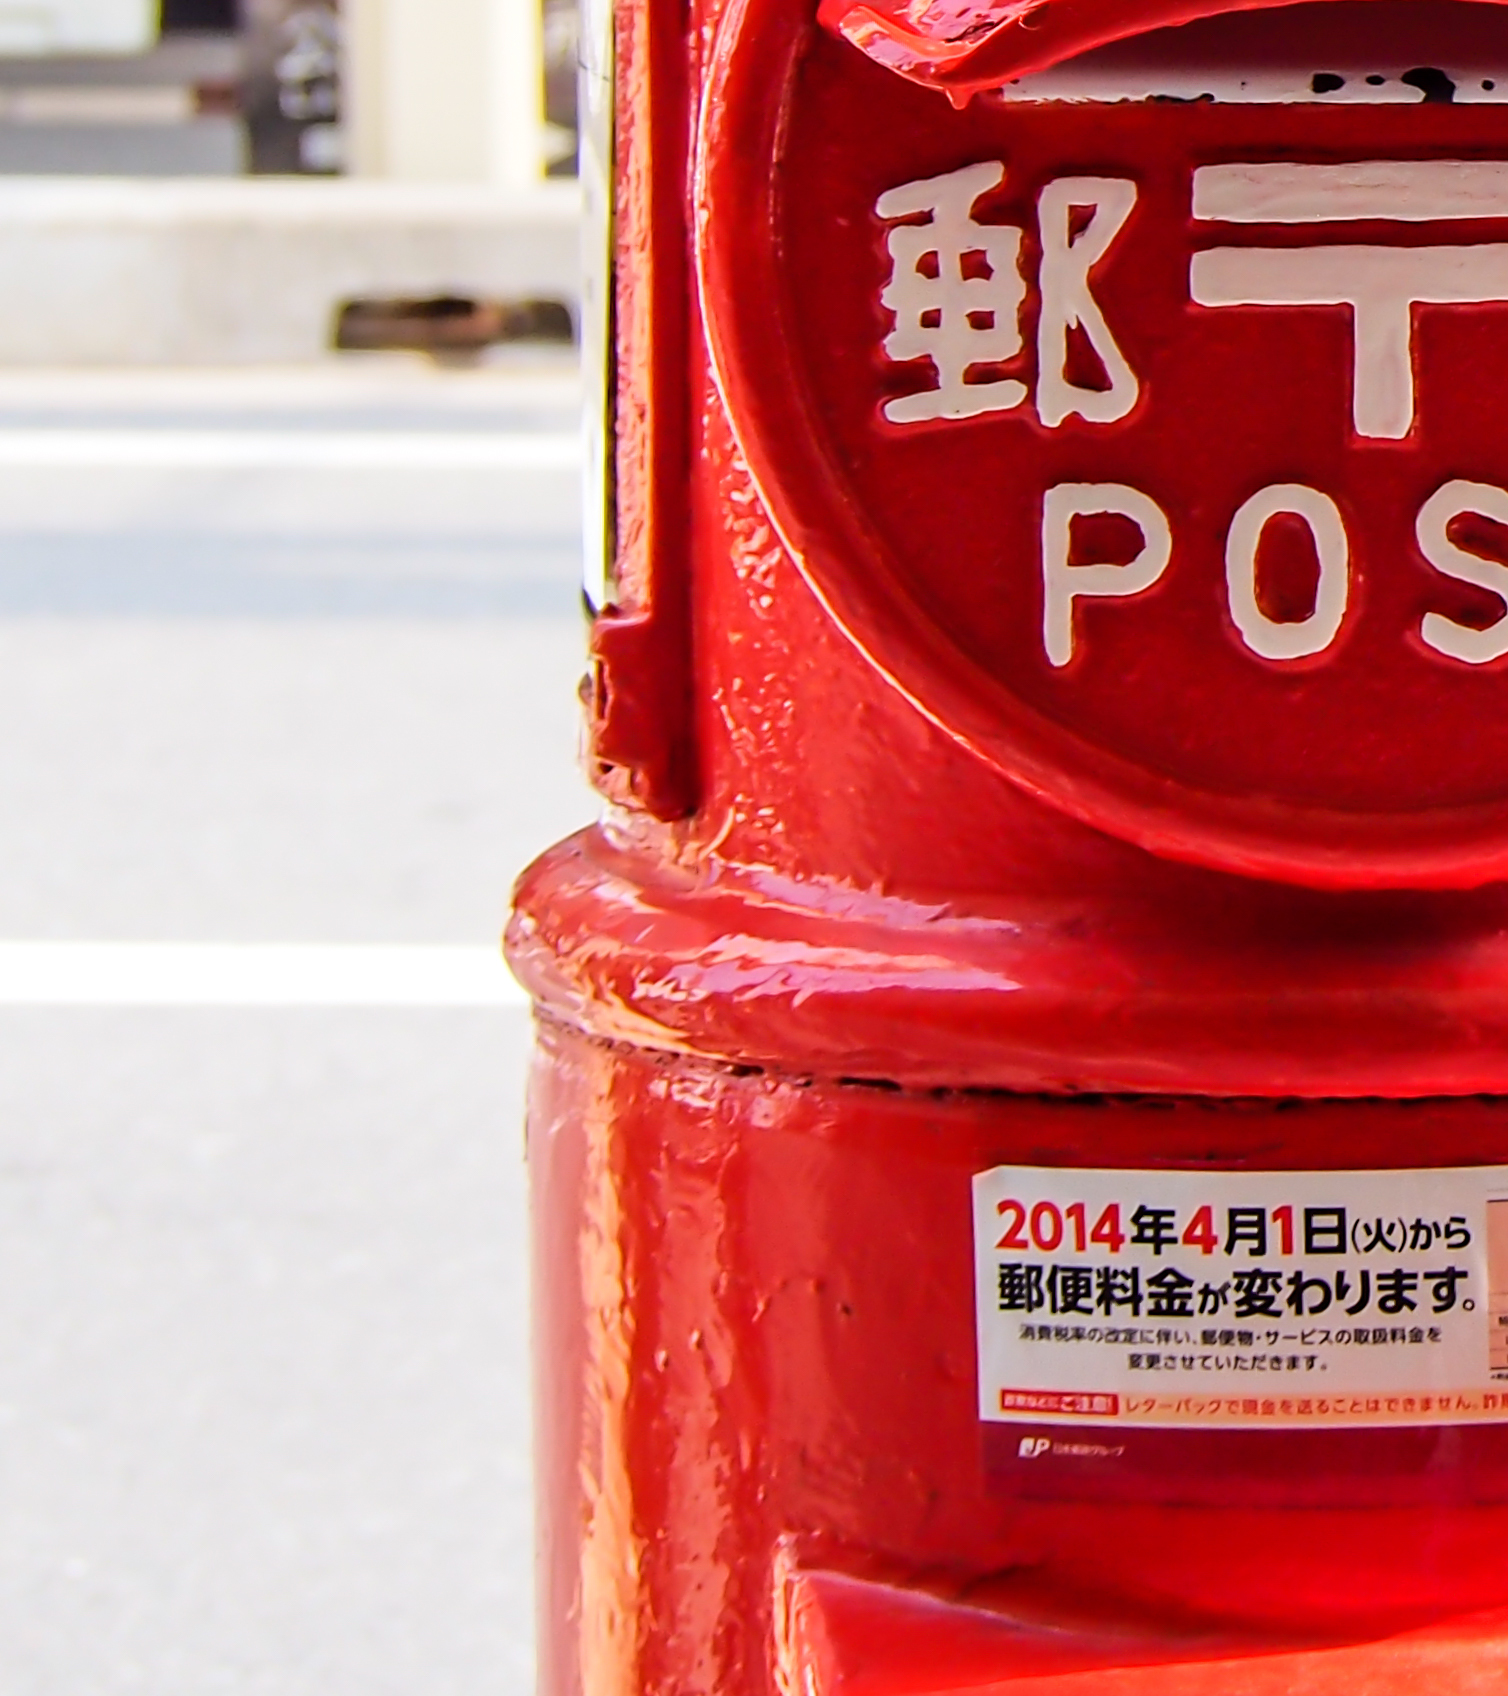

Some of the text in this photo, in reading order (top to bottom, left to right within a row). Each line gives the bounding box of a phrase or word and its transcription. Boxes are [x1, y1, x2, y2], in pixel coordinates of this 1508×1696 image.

[995, 1199, 1471, 1255] 2014年4月1日(火)から
[998, 1263, 1476, 1317] 郵便料金が変わります。
